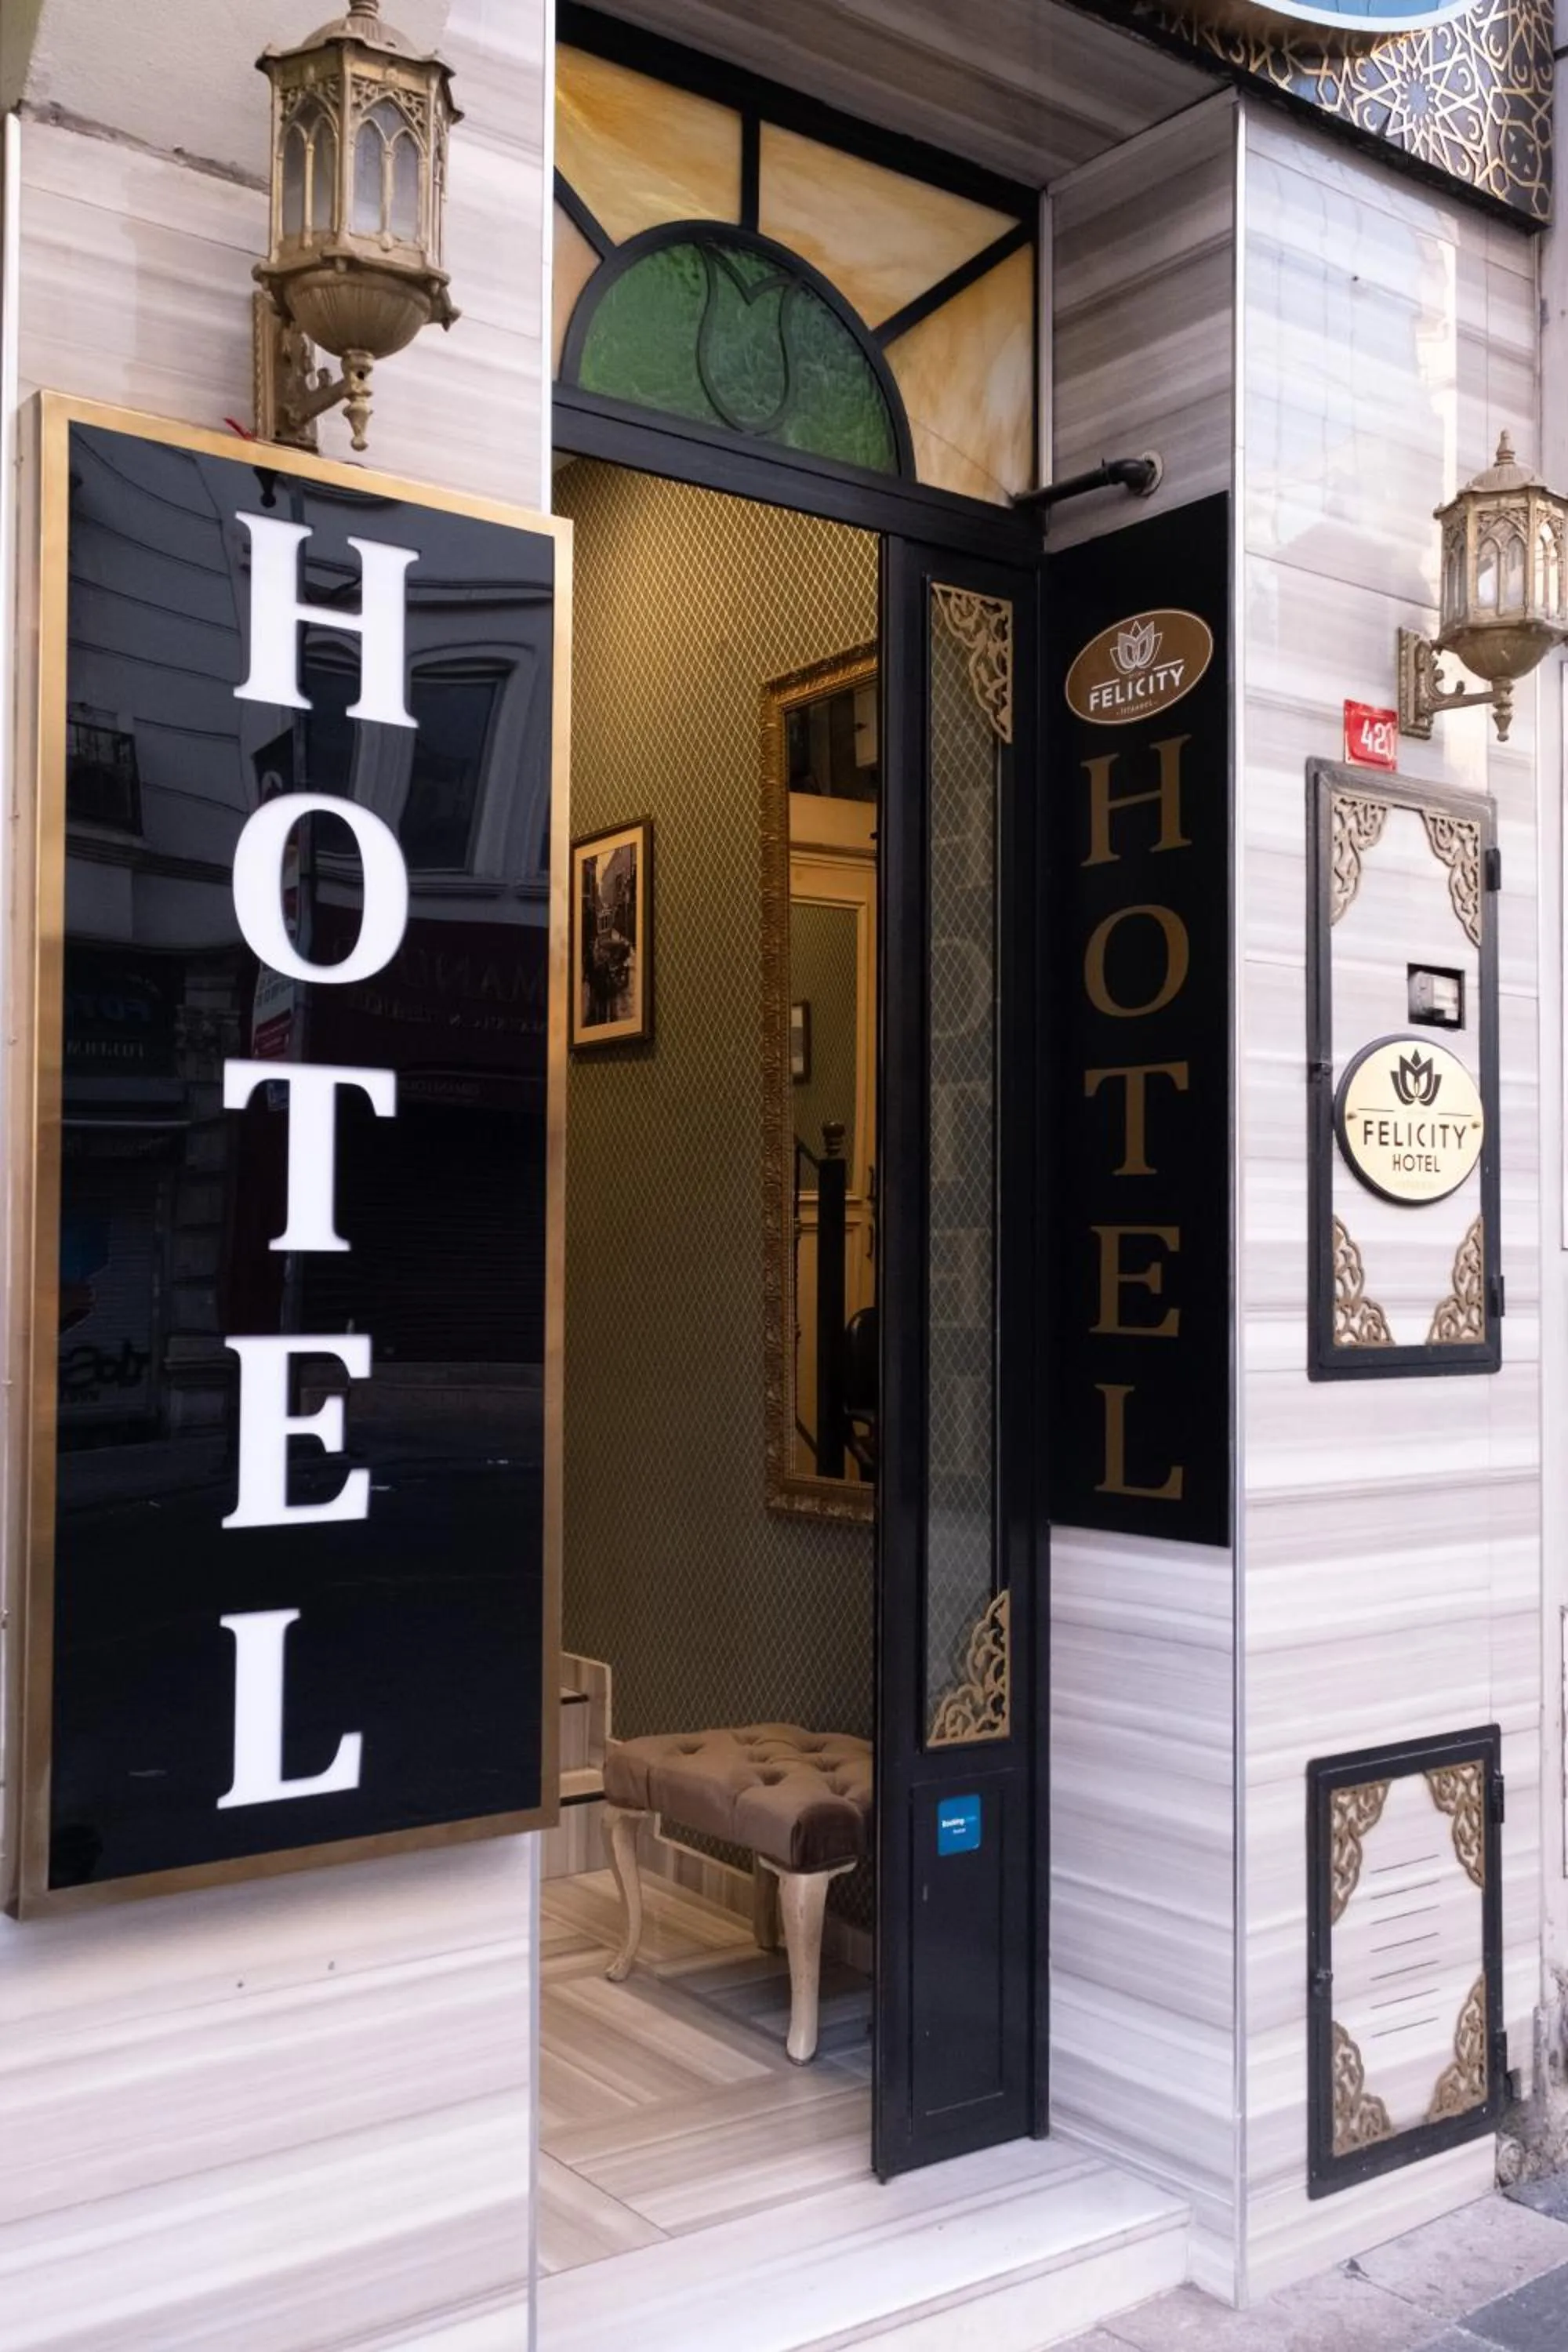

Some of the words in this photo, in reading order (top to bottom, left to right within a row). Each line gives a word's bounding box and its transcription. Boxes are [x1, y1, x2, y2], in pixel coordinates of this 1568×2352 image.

[1088, 665, 1185, 712] FELICITY
[1080, 733, 1192, 1501] HOTEL
[1363, 1120, 1467, 1149] FELICITY
[218, 511, 419, 1809] HOTEL
[1392, 1154, 1441, 1173] HOTEL
